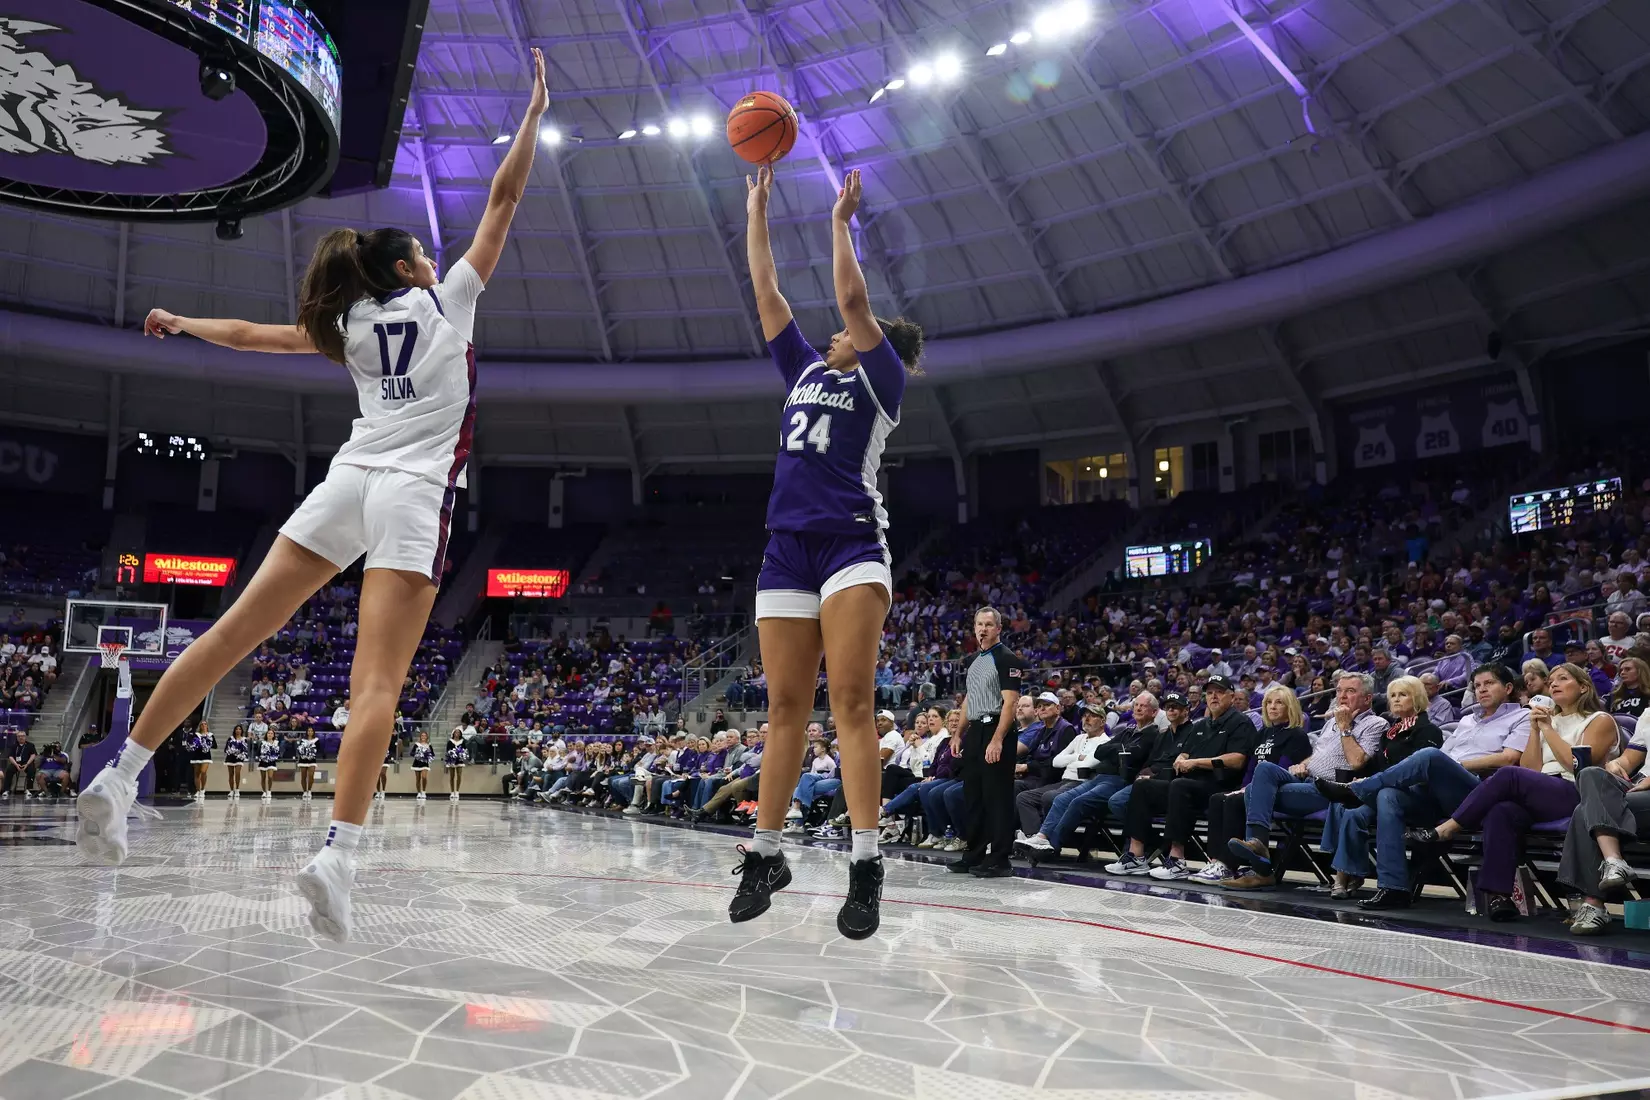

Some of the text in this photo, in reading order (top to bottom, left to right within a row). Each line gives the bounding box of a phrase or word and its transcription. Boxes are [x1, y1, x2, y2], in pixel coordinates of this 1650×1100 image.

[322, 88, 335, 117] 55
[373, 321, 419, 376] 17
[381, 377, 417, 400] SILVA
[786, 410, 833, 455] 24
[1491, 418, 1519, 437] 40
[1425, 430, 1450, 452] 28
[1362, 442, 1387, 462] 24
[119, 554, 139, 566] 1:26
[154, 558, 227, 573] Milestone
[117, 565, 136, 584] 17
[1254, 747, 1272, 756] CALM
